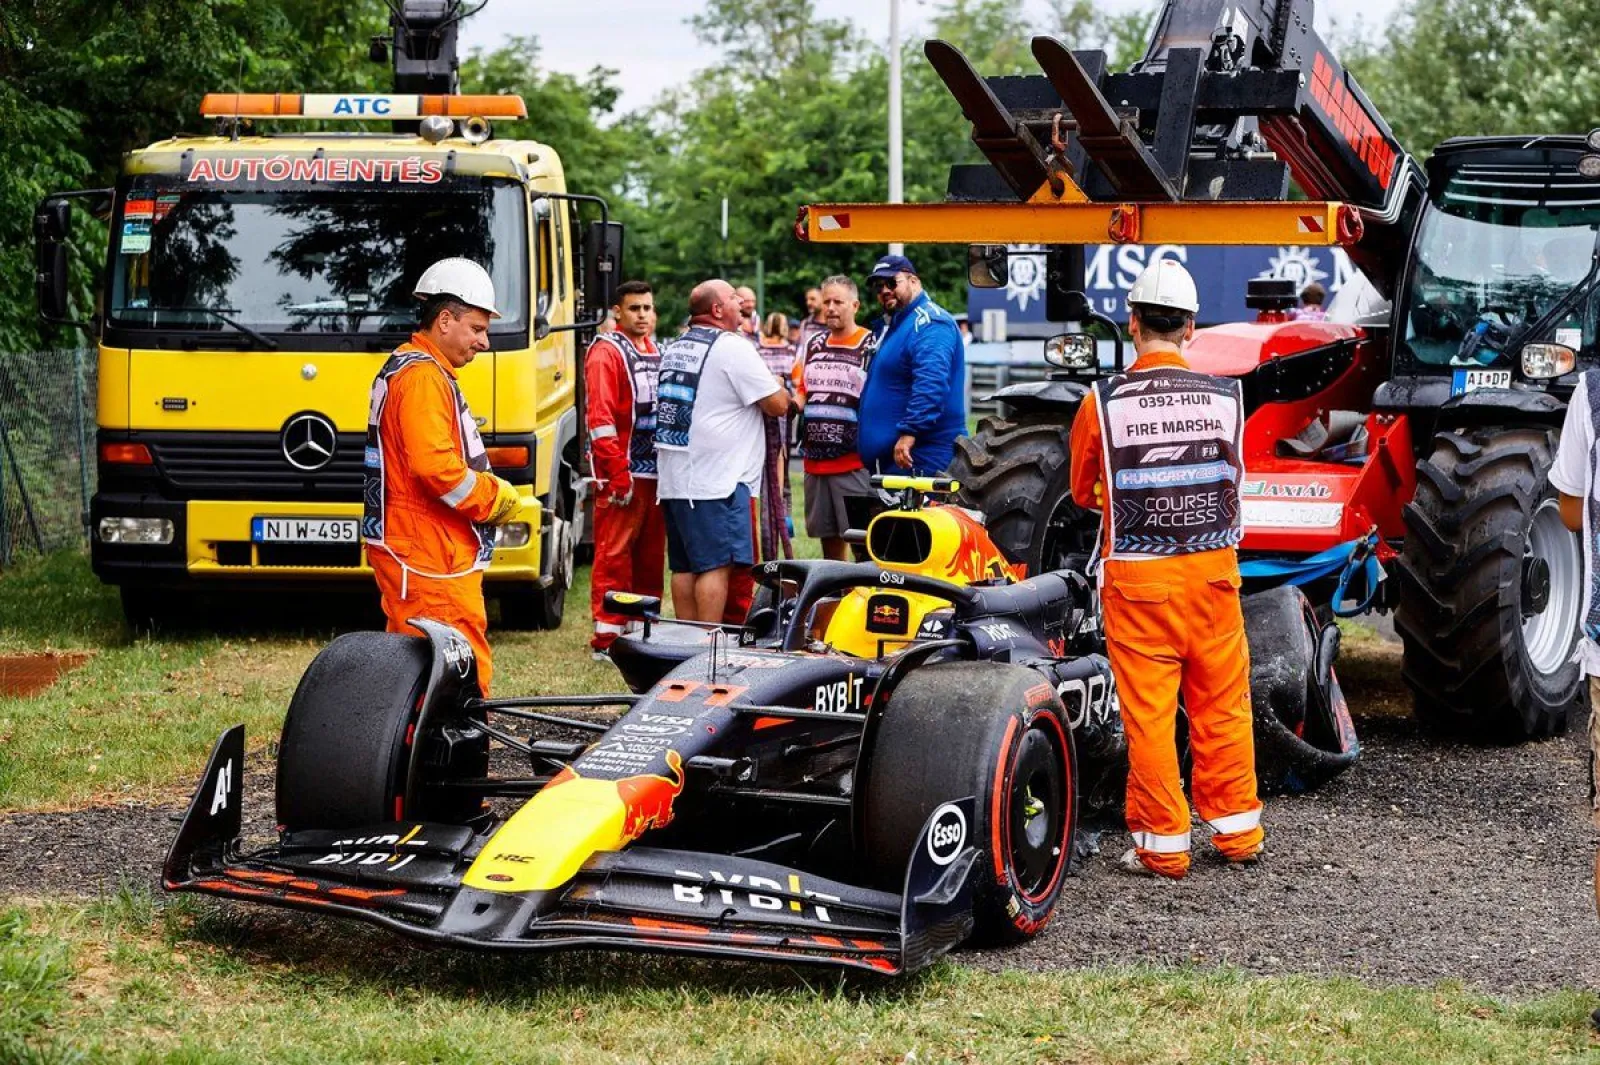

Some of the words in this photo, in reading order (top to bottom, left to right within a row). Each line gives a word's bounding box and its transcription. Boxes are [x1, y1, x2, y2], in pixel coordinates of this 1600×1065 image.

[333, 98, 391, 115] ATC
[188, 154, 443, 183] AUTÓMENTÉS
[806, 378, 825, 386] RACK
[1139, 394, 1212, 409] 0392-HUN
[807, 423, 845, 434] COURSE
[1126, 422, 1158, 437] FIRE
[1162, 419, 1226, 434] MARSHA
[807, 432, 843, 443] ACCESS
[1202, 443, 1220, 459] FIA
[1144, 491, 1219, 512] COURSE
[1144, 508, 1218, 527] ACCESS
[267, 521, 353, 540] NIW-495
[815, 673, 864, 713] BYBIT
[641, 713, 694, 726] VISA
[673, 869, 841, 923] BYBIT
